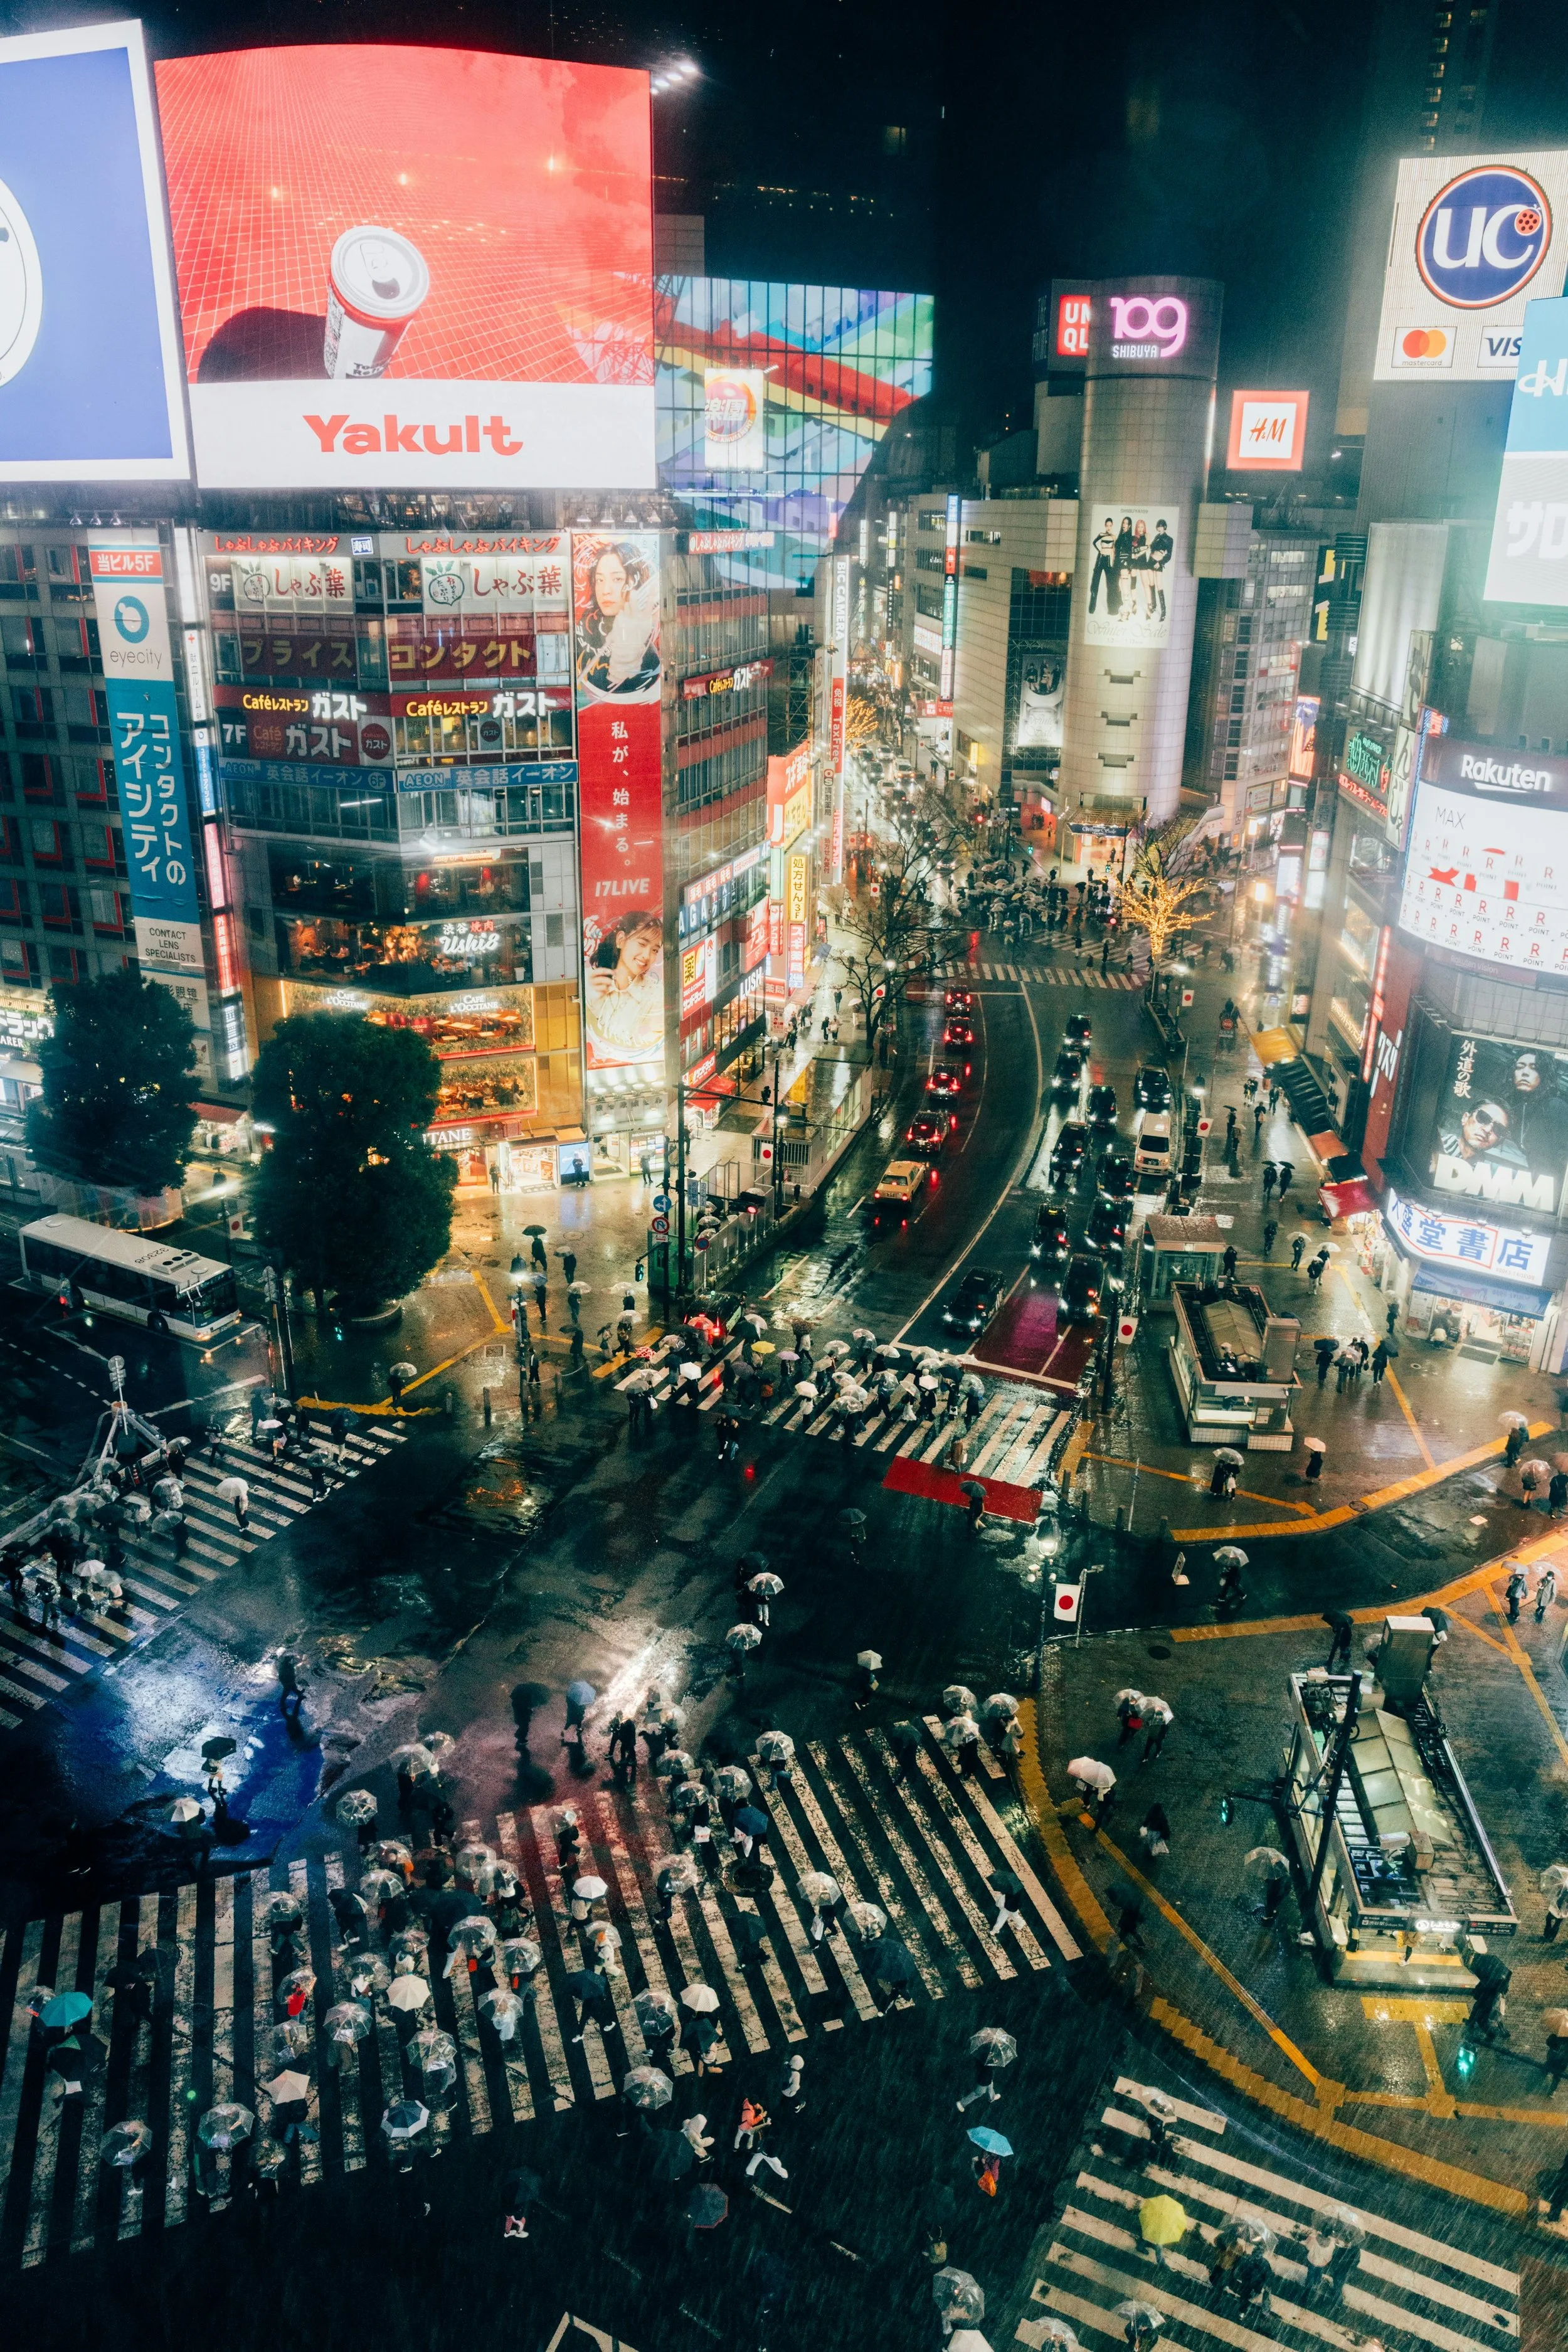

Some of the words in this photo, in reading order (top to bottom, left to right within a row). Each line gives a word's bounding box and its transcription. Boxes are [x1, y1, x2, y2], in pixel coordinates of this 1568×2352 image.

[1433, 204, 1534, 270] UC
[1110, 297, 1187, 358] 109
[1113, 345, 1158, 359] SHIBUYA
[302, 415, 524, 456] Yakult
[1249, 417, 1287, 443] H&M
[215, 535, 339, 554] しゃぶしゃぶバイキング
[353, 539, 372, 553] 寿司
[406, 536, 561, 553] しゃぶしゃぶバイキング
[97, 553, 154, 573] 当ビル5F
[836, 561, 846, 583] BIC
[210, 573, 231, 592] 9F
[275, 568, 345, 599] しゃぶ葉
[474, 564, 563, 596] しゃぶ葉
[835, 588, 846, 641] CAMERA
[1086, 620, 1127, 637] Winter
[110, 649, 162, 669] eyecity
[243, 640, 354, 665] プライス
[391, 640, 533, 669] コンタクト
[243, 694, 309, 712] Caféレストラン
[312, 692, 368, 721] ガスト
[406, 699, 488, 717] Caféレストラン
[492, 692, 557, 719] ガスト
[223, 724, 246, 744] 7F
[286, 724, 352, 758] ガスト
[365, 739, 388, 750] ガスト
[226, 762, 255, 776] AEON
[267, 765, 363, 785] 英会話イーオン
[405, 773, 445, 787] AEON
[455, 766, 573, 786] 英会話イーオン
[1461, 754, 1552, 792] Rakuten
[117, 712, 158, 883] アイシティ
[150, 714, 187, 886] コンタクトの
[611, 721, 631, 866] 私が、始まる。
[1435, 805, 1466, 830] MAX
[595, 877, 650, 898] 17LIVE
[793, 857, 804, 919] 処方せん3F
[1454, 893, 1462, 907] R
[1479, 899, 1486, 913] R
[679, 895, 707, 937] AGA
[1449, 908, 1465, 916] POINT
[1472, 914, 1490, 923] POINT
[1506, 906, 1515, 919] R
[1536, 911, 1545, 925] R
[149, 927, 186, 940] CONTACT
[443, 922, 469, 935] 渋谷
[470, 919, 494, 933] 焼肉
[1499, 921, 1518, 930] POINT
[1528, 926, 1550, 936] POINT
[158, 940, 179, 950] LENS
[439, 932, 501, 955] Ushi8
[1474, 930, 1481, 943] R
[1501, 936, 1509, 950] R
[146, 948, 196, 963] SPECIALISTS
[791, 926, 803, 972] スギ薬局
[1494, 951, 1513, 960] POINT
[1531, 943, 1540, 956] R
[685, 955, 694, 985] 薬
[1523, 958, 1544, 967] POINT
[740, 967, 763, 1002] LUSH
[765, 983, 784, 994] 薬局
[326, 996, 368, 1010] L'OCCITANE
[337, 990, 356, 1002] CAFÉ
[463, 994, 484, 1004] CAFÉ
[683, 987, 706, 1012] サンドラッグ
[450, 1002, 499, 1014] L'OCCITANE
[1453, 1039, 1478, 1099] 外道の歌
[1433, 1153, 1554, 1212] DMM
[134, 1247, 169, 1264] 32308
